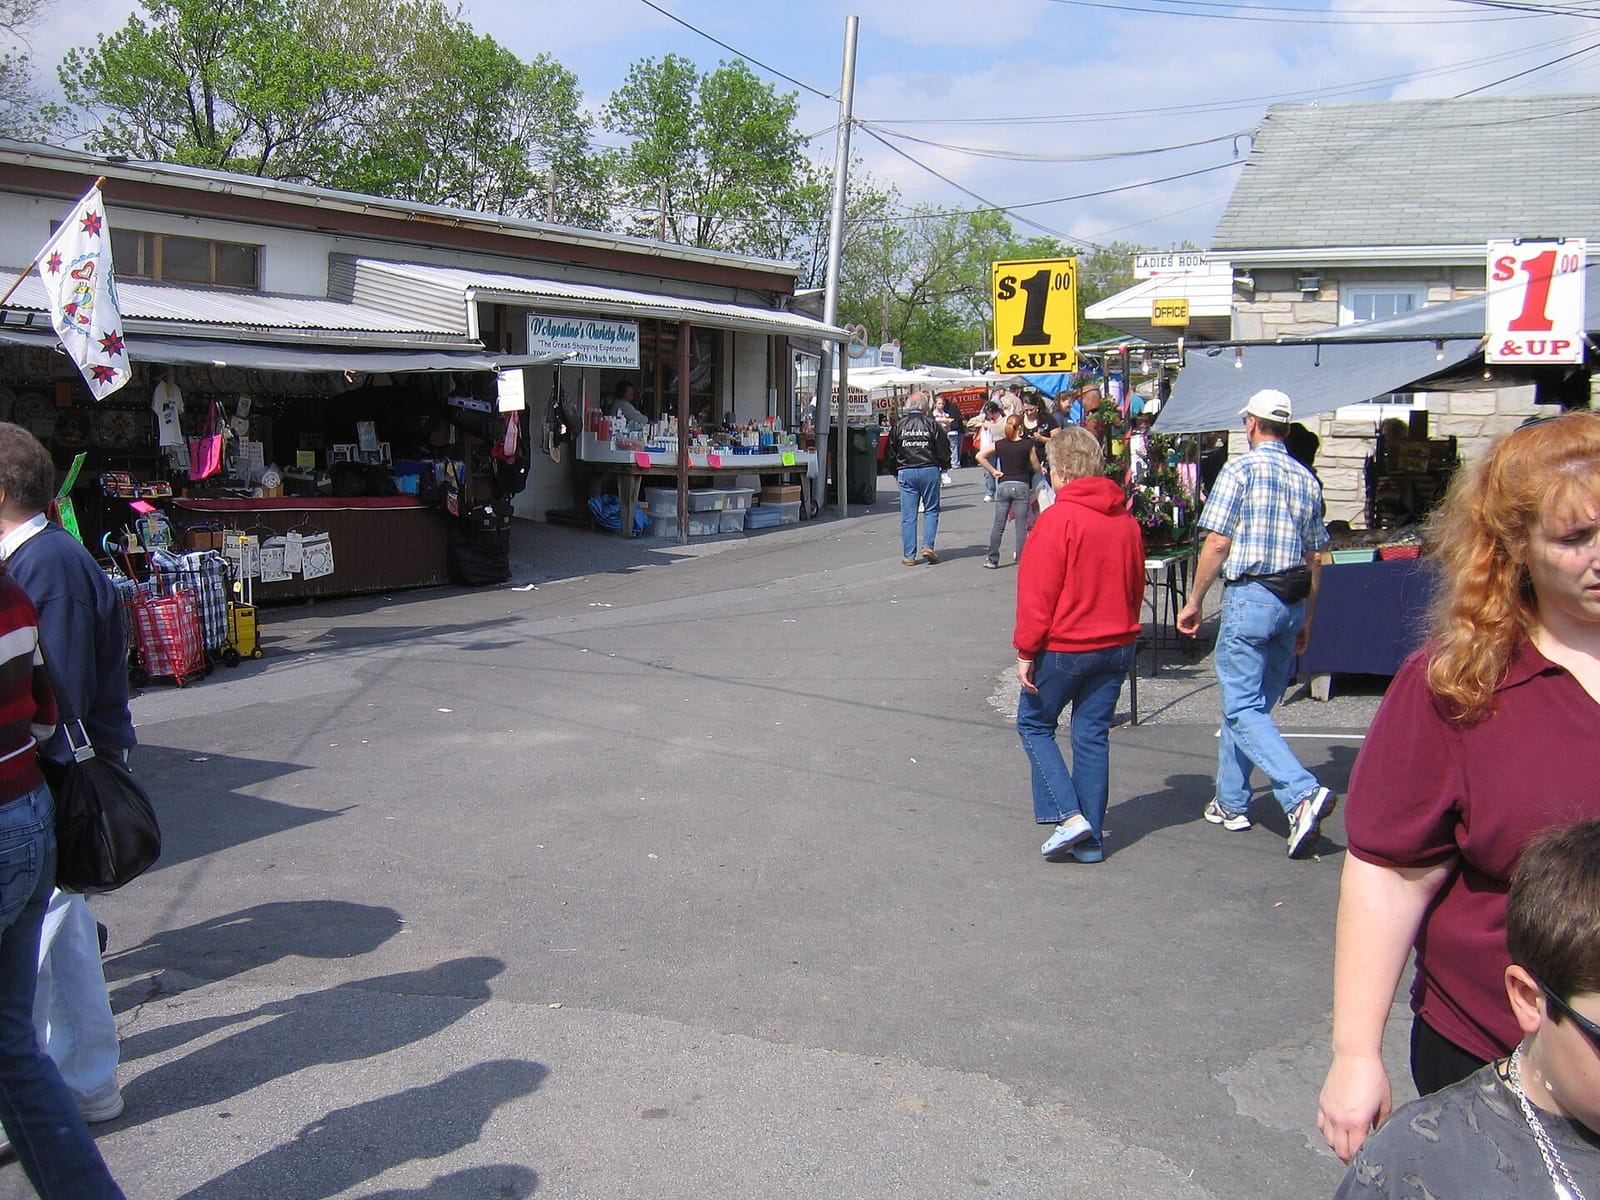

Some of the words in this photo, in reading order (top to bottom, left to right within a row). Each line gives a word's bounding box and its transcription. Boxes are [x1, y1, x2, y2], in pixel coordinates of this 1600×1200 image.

[1136, 256, 1173, 268] LADIES
[997, 269, 1070, 346] $1.00
[1154, 306, 1186, 318] OFFICE
[531, 317, 584, 339] D'Agostino's
[586, 322, 616, 344] Variety
[617, 325, 635, 343] Store
[552, 340, 571, 349] Great
[572, 342, 598, 353] Shopping
